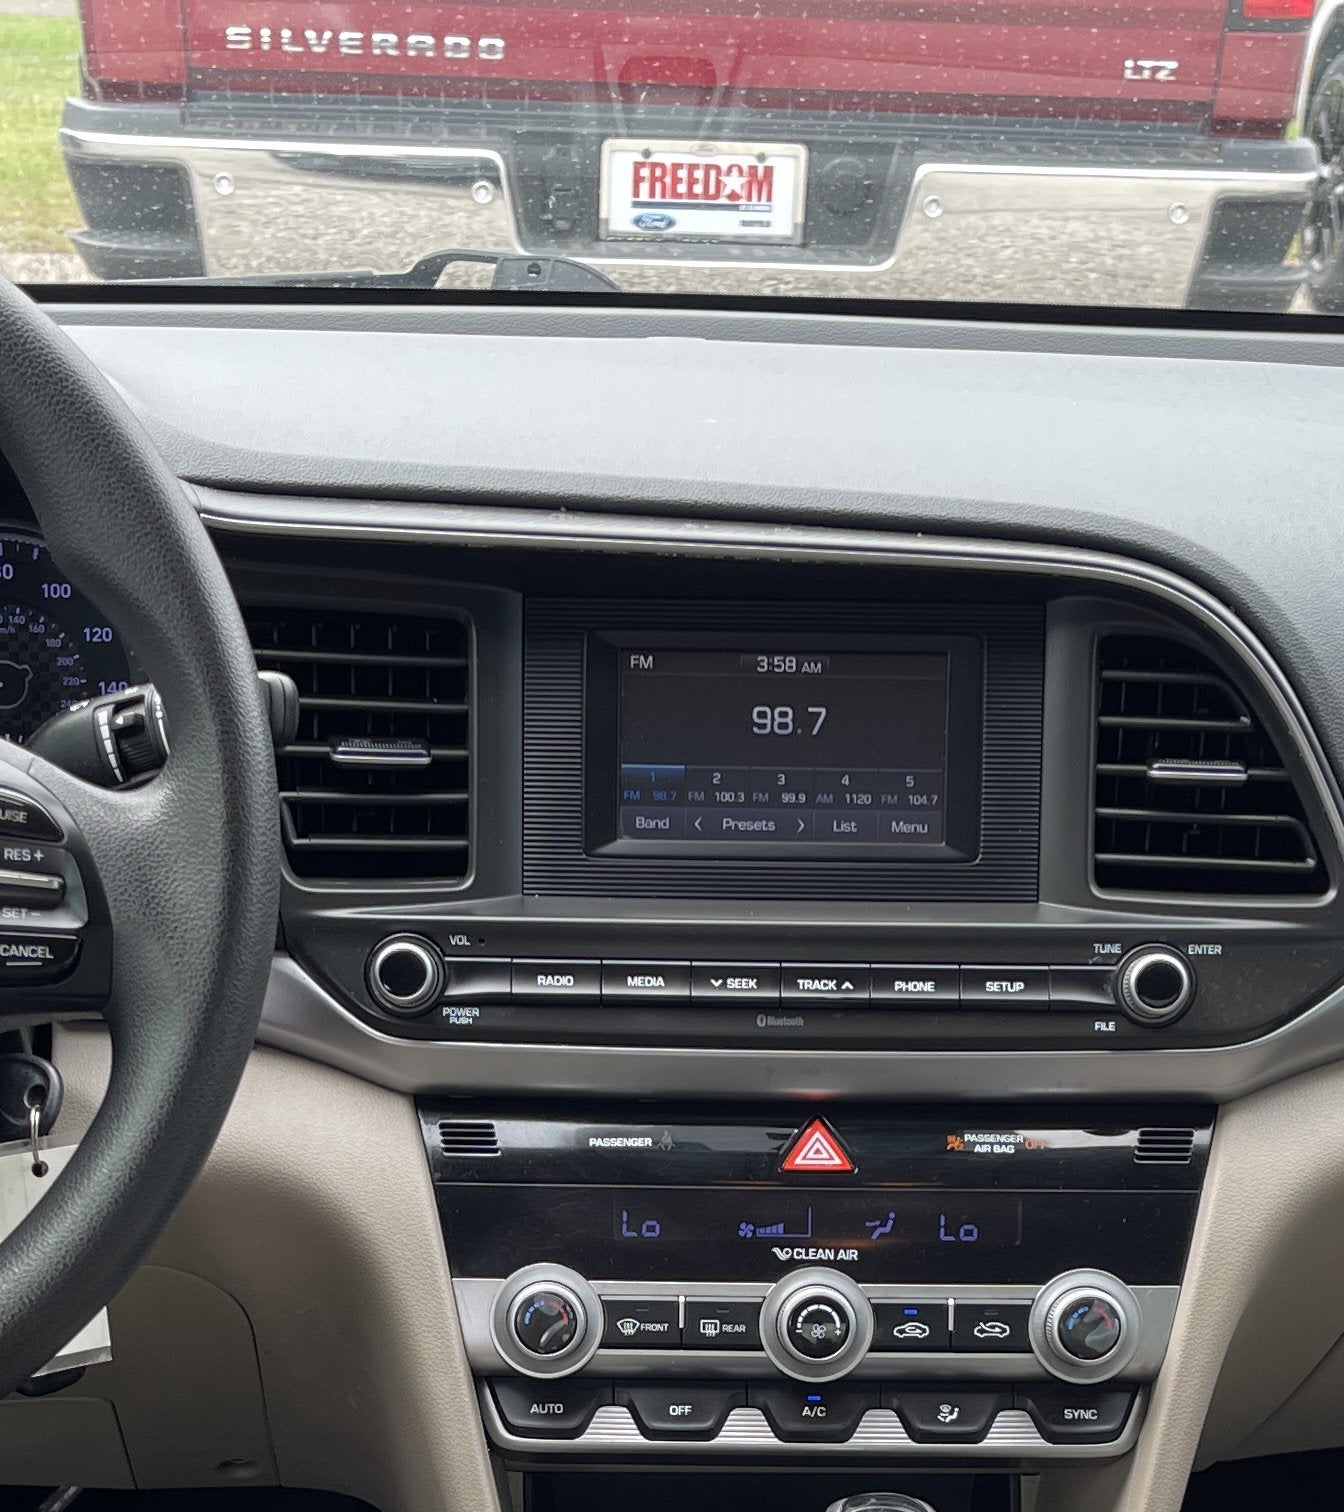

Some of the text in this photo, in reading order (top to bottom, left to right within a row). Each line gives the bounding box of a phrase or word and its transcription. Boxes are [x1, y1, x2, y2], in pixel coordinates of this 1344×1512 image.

[225, 27, 505, 60] SILVERADO
[1123, 58, 1180, 80] LTZ
[632, 162, 774, 202] FREEDOM
[41, 583, 72, 600] 100
[83, 626, 113, 644] 120
[629, 654, 654, 671] FM
[756, 655, 822, 675] 3:58 AM
[752, 706, 828, 736] 98.7
[650, 773, 656, 783] 1
[712, 773, 722, 785] 2
[777, 774, 787, 786] 3
[841, 775, 851, 787] 4
[906, 777, 915, 788] 5
[623, 790, 641, 800] FM
[688, 792, 745, 803] FM 100.3
[753, 793, 806, 804] FM 99.9
[816, 793, 872, 805] AM 1120
[882, 794, 938, 806] FM 104.7
[635, 817, 670, 829] Band
[722, 819, 776, 832] Presets
[833, 820, 857, 833] List
[891, 821, 928, 834] Menu
[3, 847, 31, 862] RES
[449, 935, 471, 946] VOL
[0, 943, 55, 959] CANCEL
[1093, 943, 1122, 954] TUNE
[1188, 944, 1222, 955] ENTER
[537, 975, 574, 987] RADIO
[627, 976, 665, 987] MEDIA
[726, 978, 757, 989] SEEK
[796, 979, 837, 991] TRACK
[894, 981, 935, 992] PHONE
[985, 981, 1025, 993] SETUP
[442, 1007, 479, 1018] POWER
[449, 1016, 472, 1025] PUSH
[1094, 1022, 1116, 1032] FILE
[588, 1137, 652, 1148] PASSENGER
[964, 1133, 1024, 1143] PASSENGER
[974, 1144, 1015, 1154] AIR BAG
[620, 1209, 662, 1238] Lo
[939, 1214, 979, 1242] Lo
[792, 1248, 858, 1261] CLEAN AIR
[640, 1323, 669, 1333] FRONT
[722, 1324, 746, 1333] REAR
[530, 1403, 564, 1415] AUTO
[669, 1405, 693, 1416] OFF
[802, 1406, 826, 1418] A/C
[1064, 1408, 1098, 1420] SYNC
